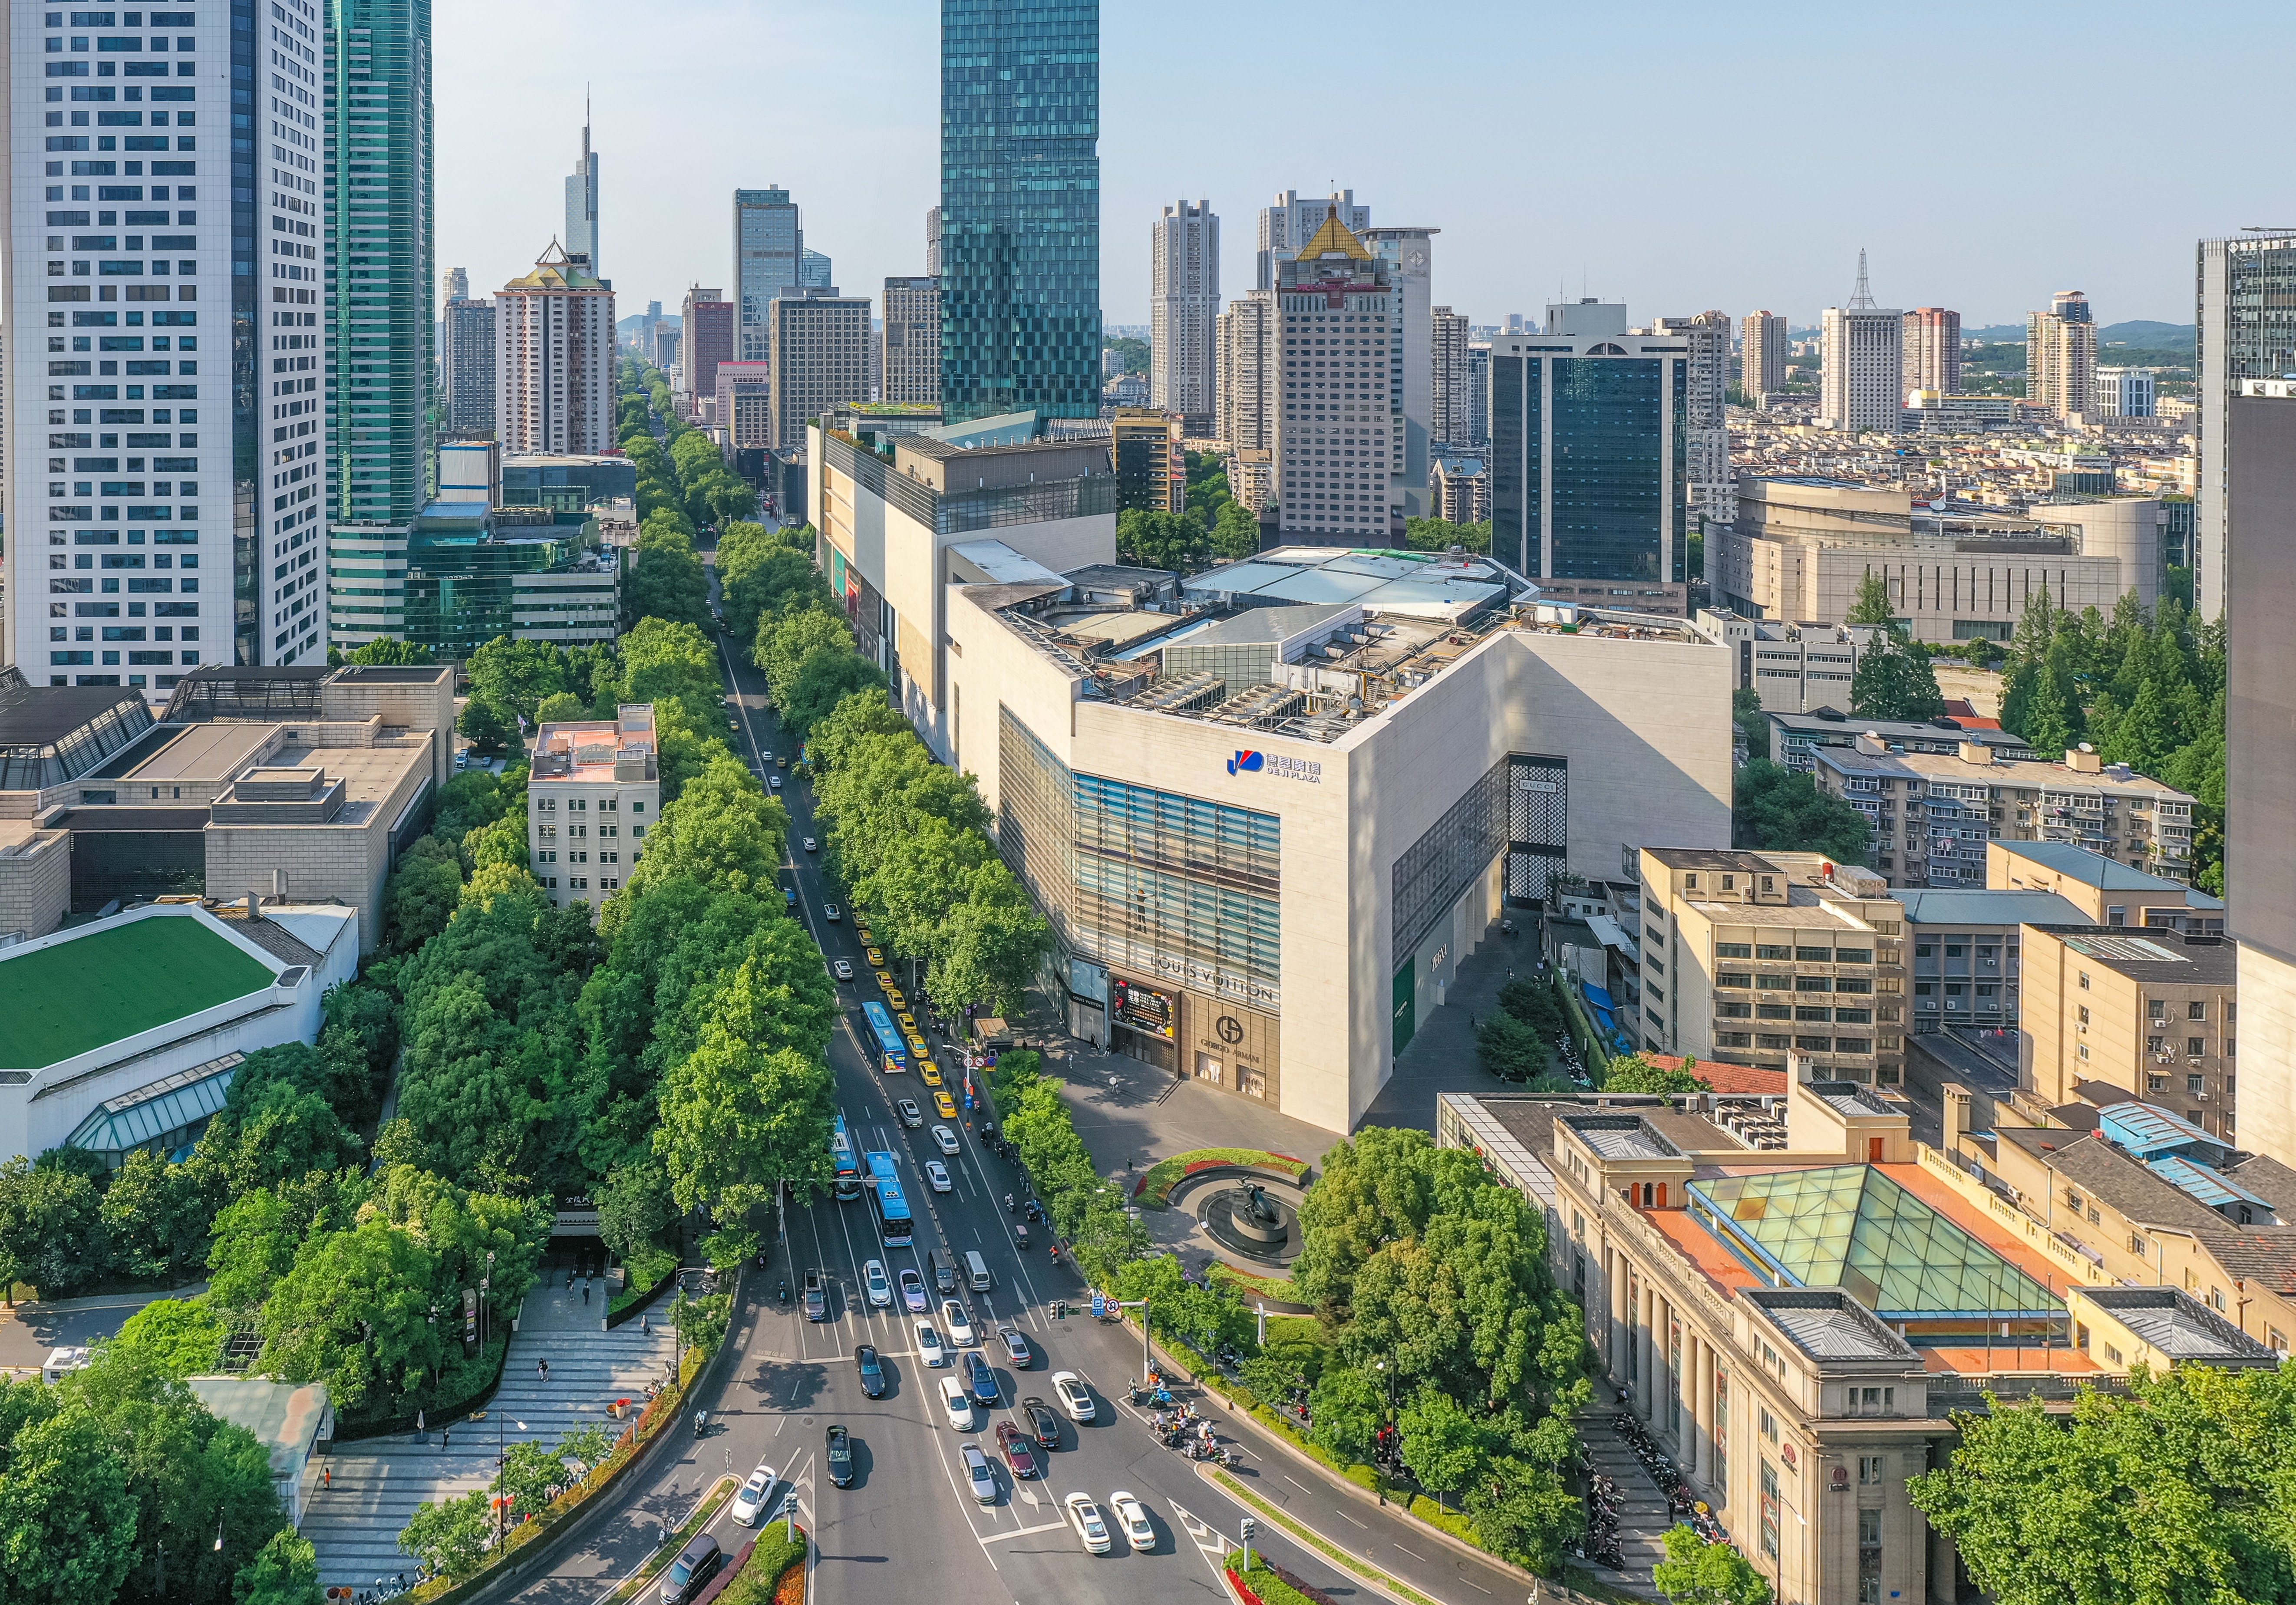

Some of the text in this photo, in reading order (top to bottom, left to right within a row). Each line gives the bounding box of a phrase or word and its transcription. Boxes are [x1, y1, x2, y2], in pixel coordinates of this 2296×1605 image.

[1266, 753, 1321, 775] 德基廣場
[1291, 771, 1321, 784] PLAZA
[1522, 782, 1553, 790] GUCCI
[1431, 943, 1448, 972] ZEGNA
[1151, 953, 1273, 1002] LOUIS VUITTON
[1085, 999, 1102, 1008] VUITTON
[1201, 1038, 1260, 1064] GIORGIO ARMANI
[565, 1195, 592, 1203] 金陵风
